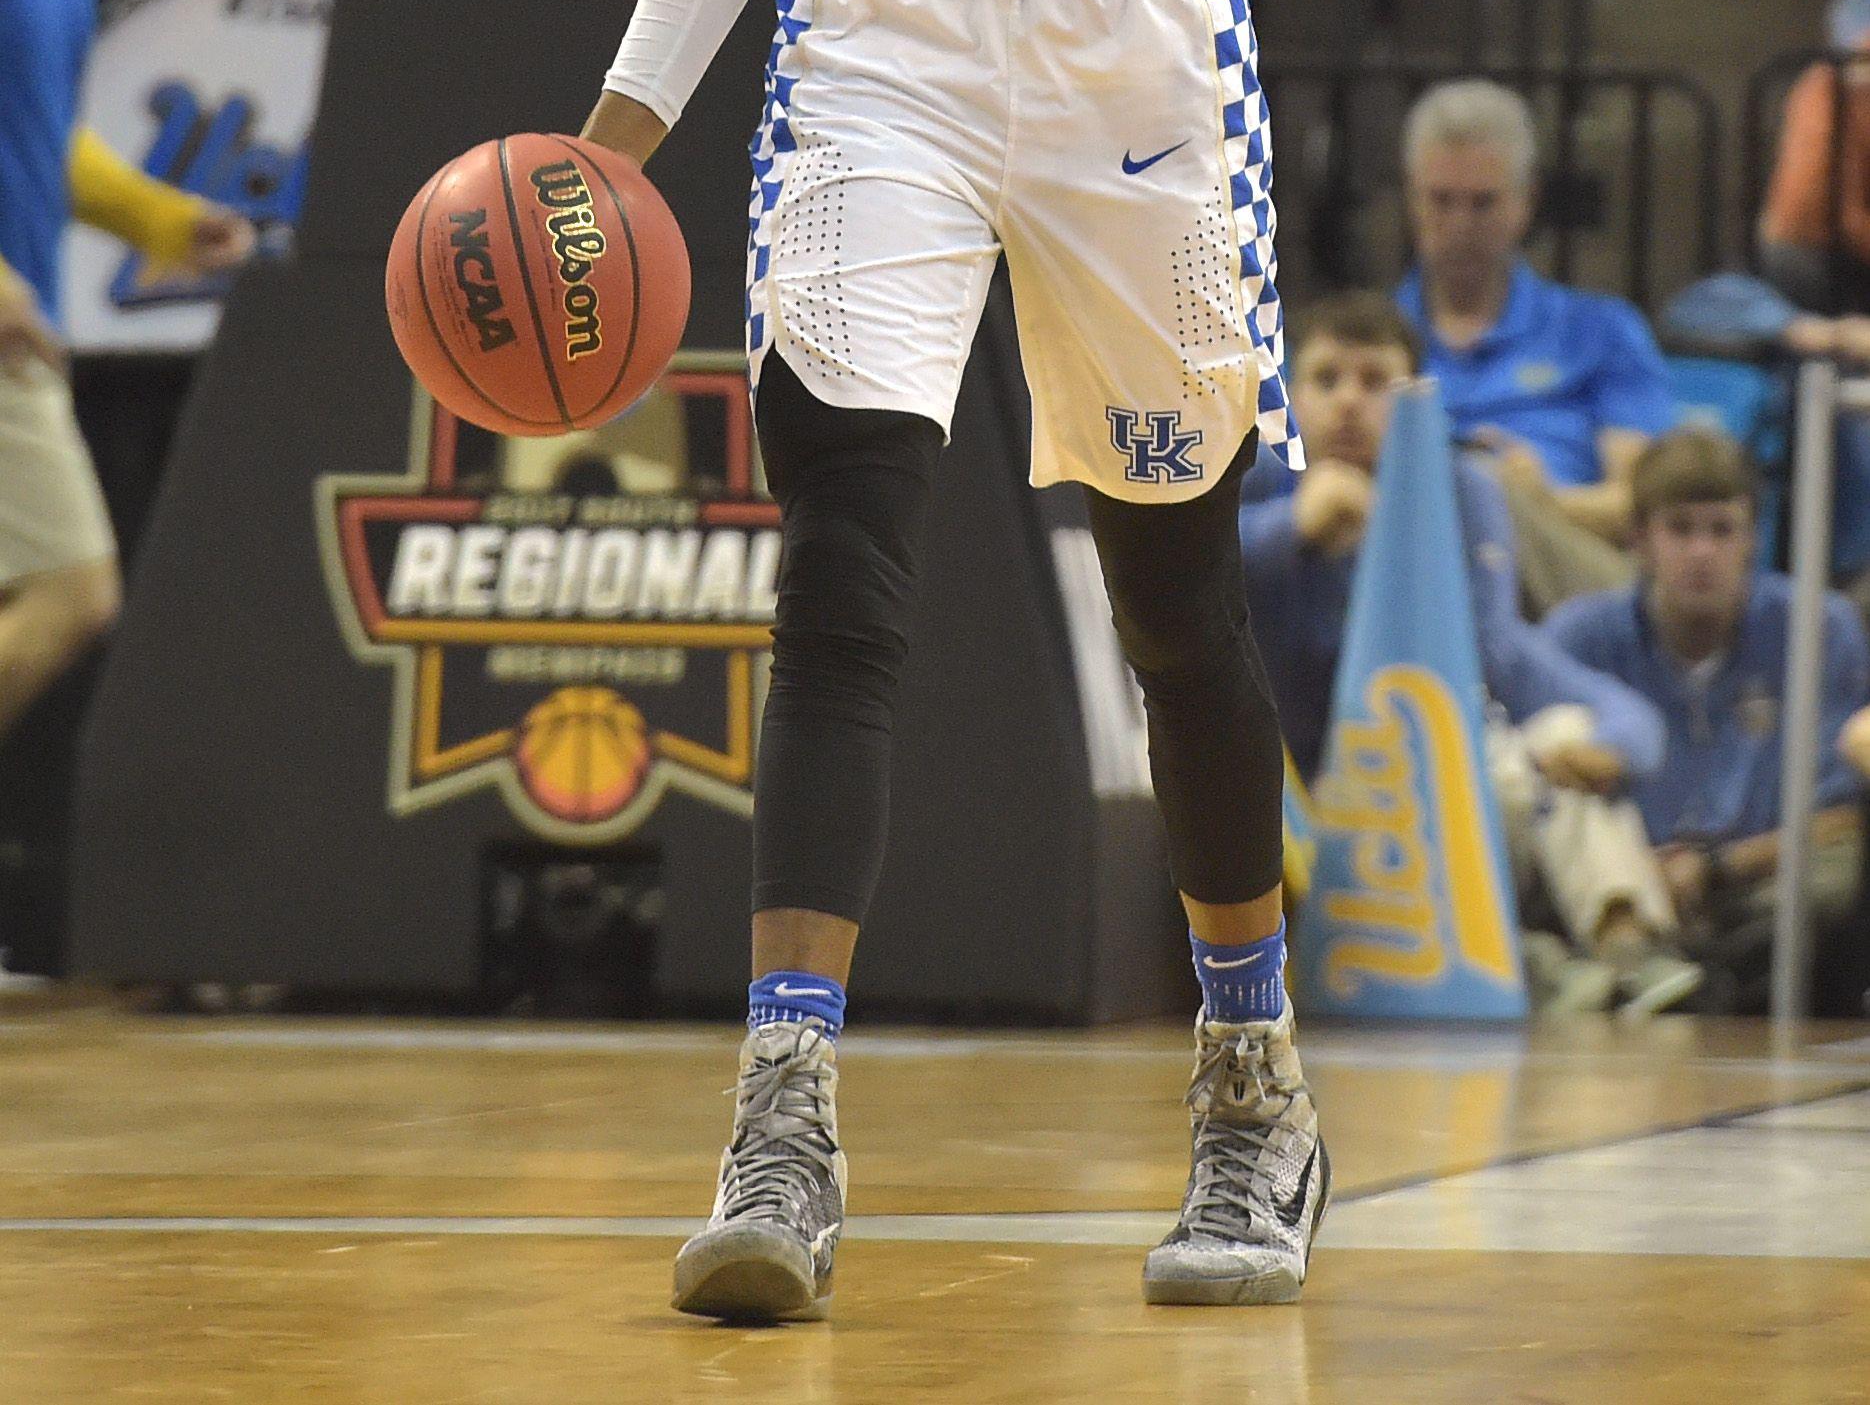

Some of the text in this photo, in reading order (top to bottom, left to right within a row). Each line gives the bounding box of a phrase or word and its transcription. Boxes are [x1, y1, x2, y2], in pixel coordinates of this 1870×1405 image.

[449, 207, 518, 353] NCAA
[528, 158, 606, 362] Wilson
[1105, 405, 1203, 483] UK
[387, 523, 783, 621] REGIONAL
